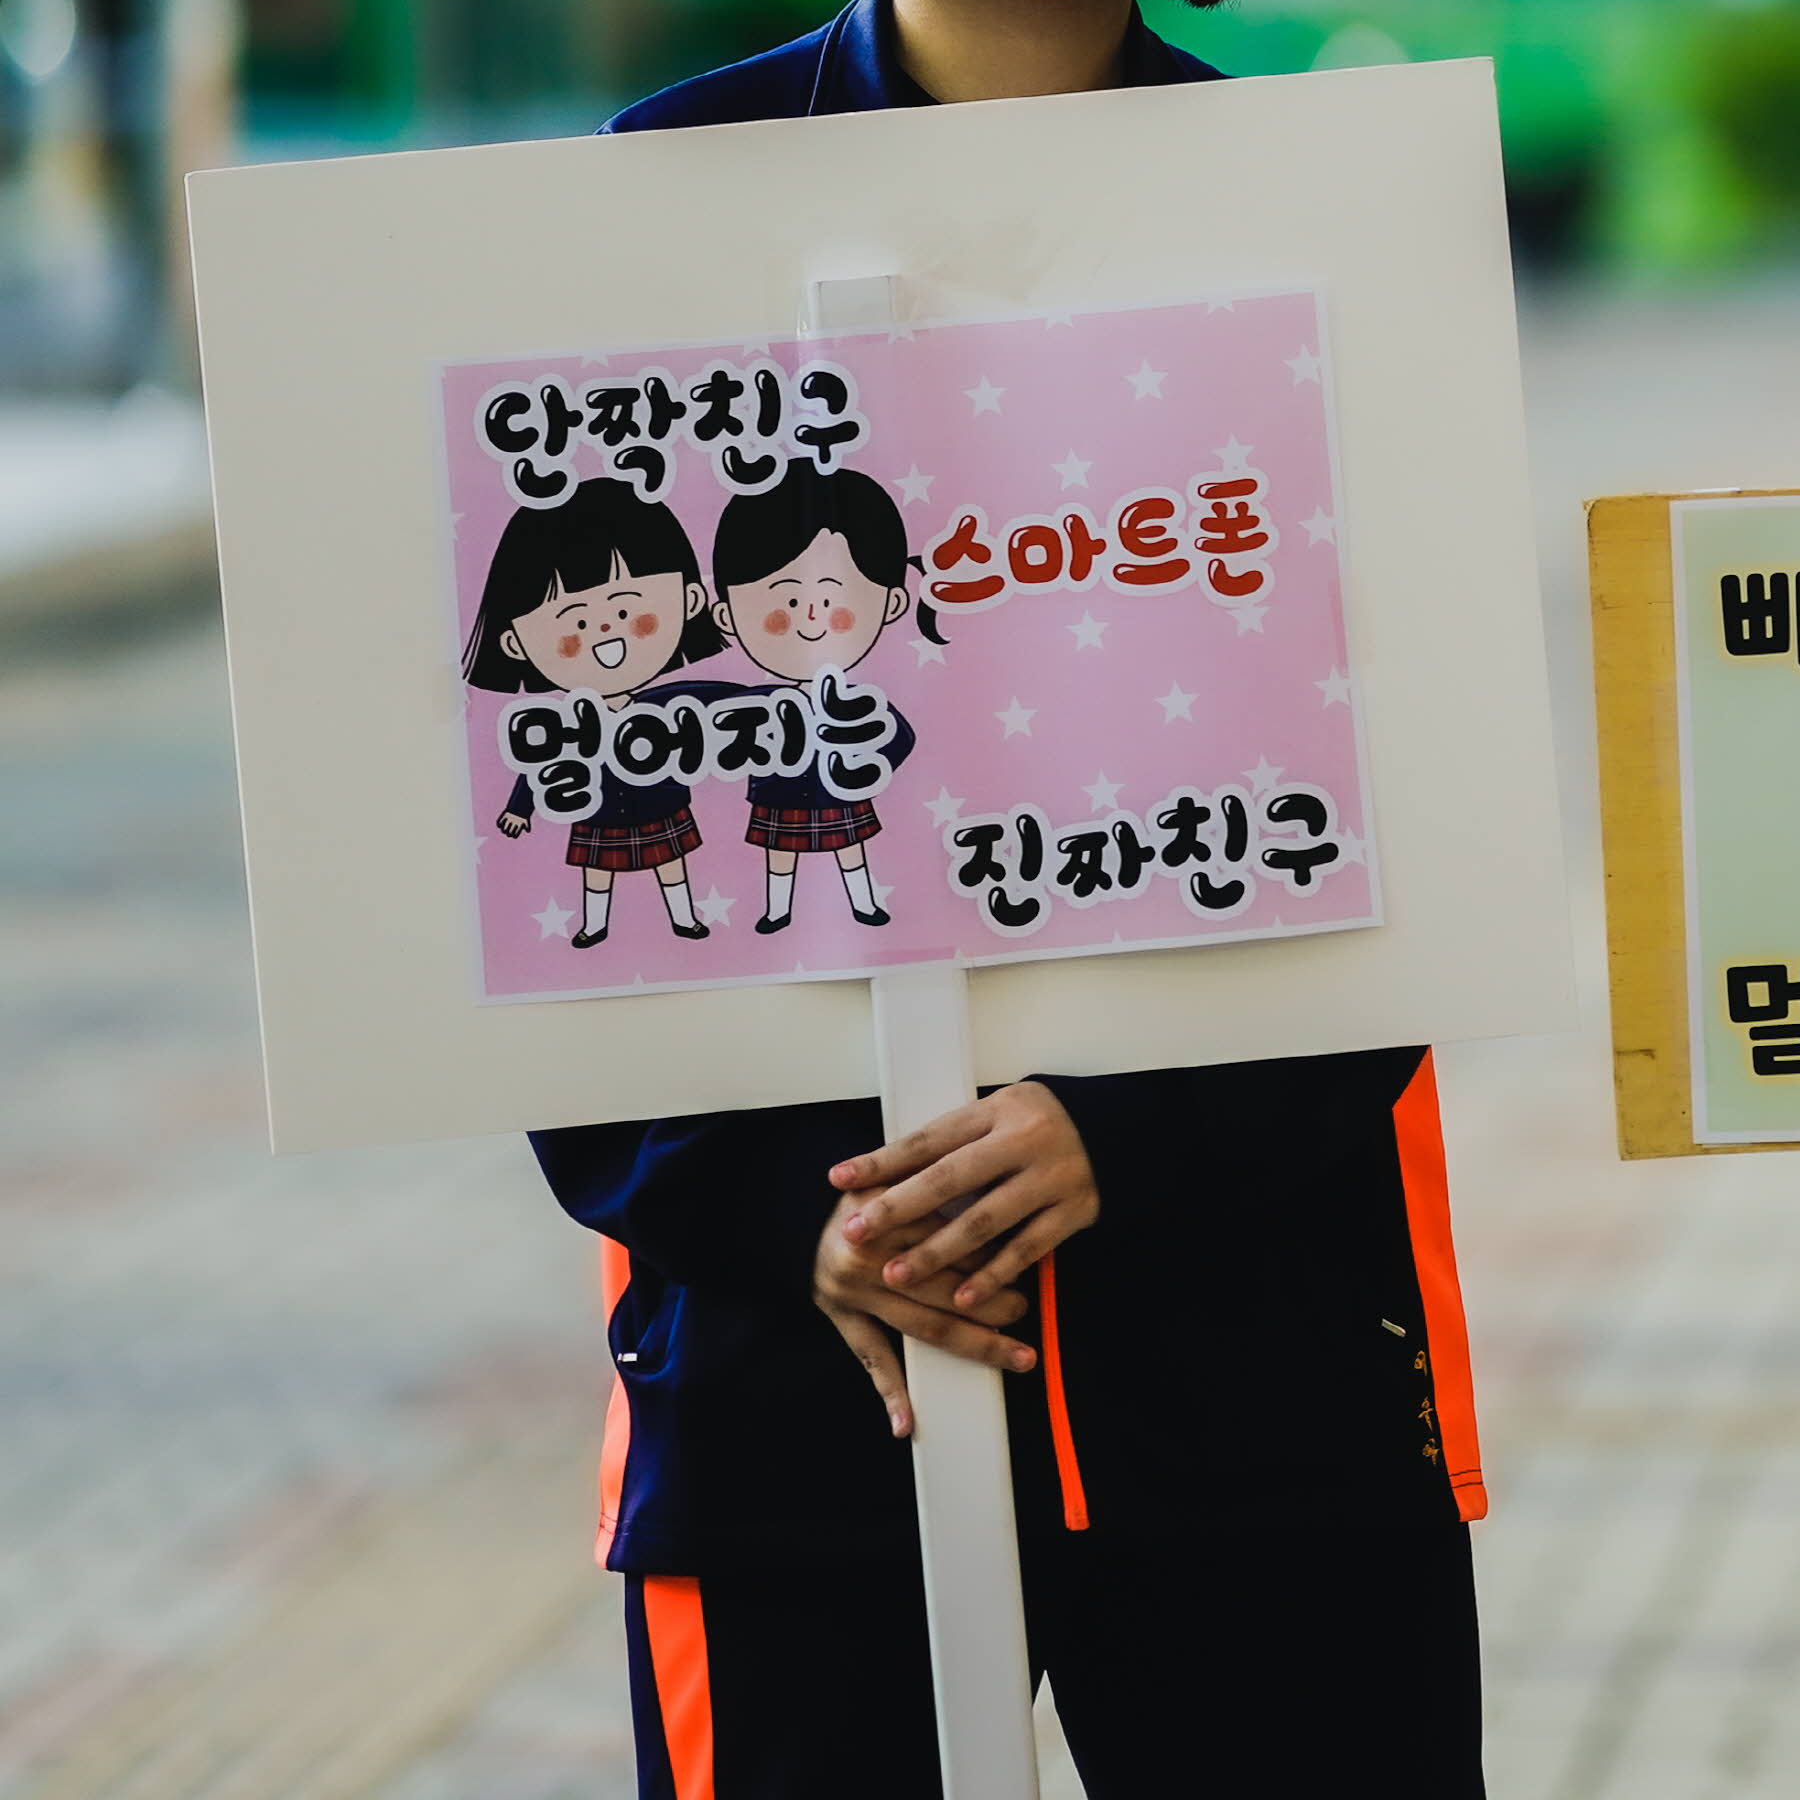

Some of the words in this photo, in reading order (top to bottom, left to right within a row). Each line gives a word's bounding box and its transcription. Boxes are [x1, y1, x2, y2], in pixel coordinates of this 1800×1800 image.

[484, 366, 863, 503] 단짝친구
[927, 476, 1271, 605] 스마트폰
[506, 673, 894, 813] 멀어지는
[955, 791, 1341, 928] 진짜친구
